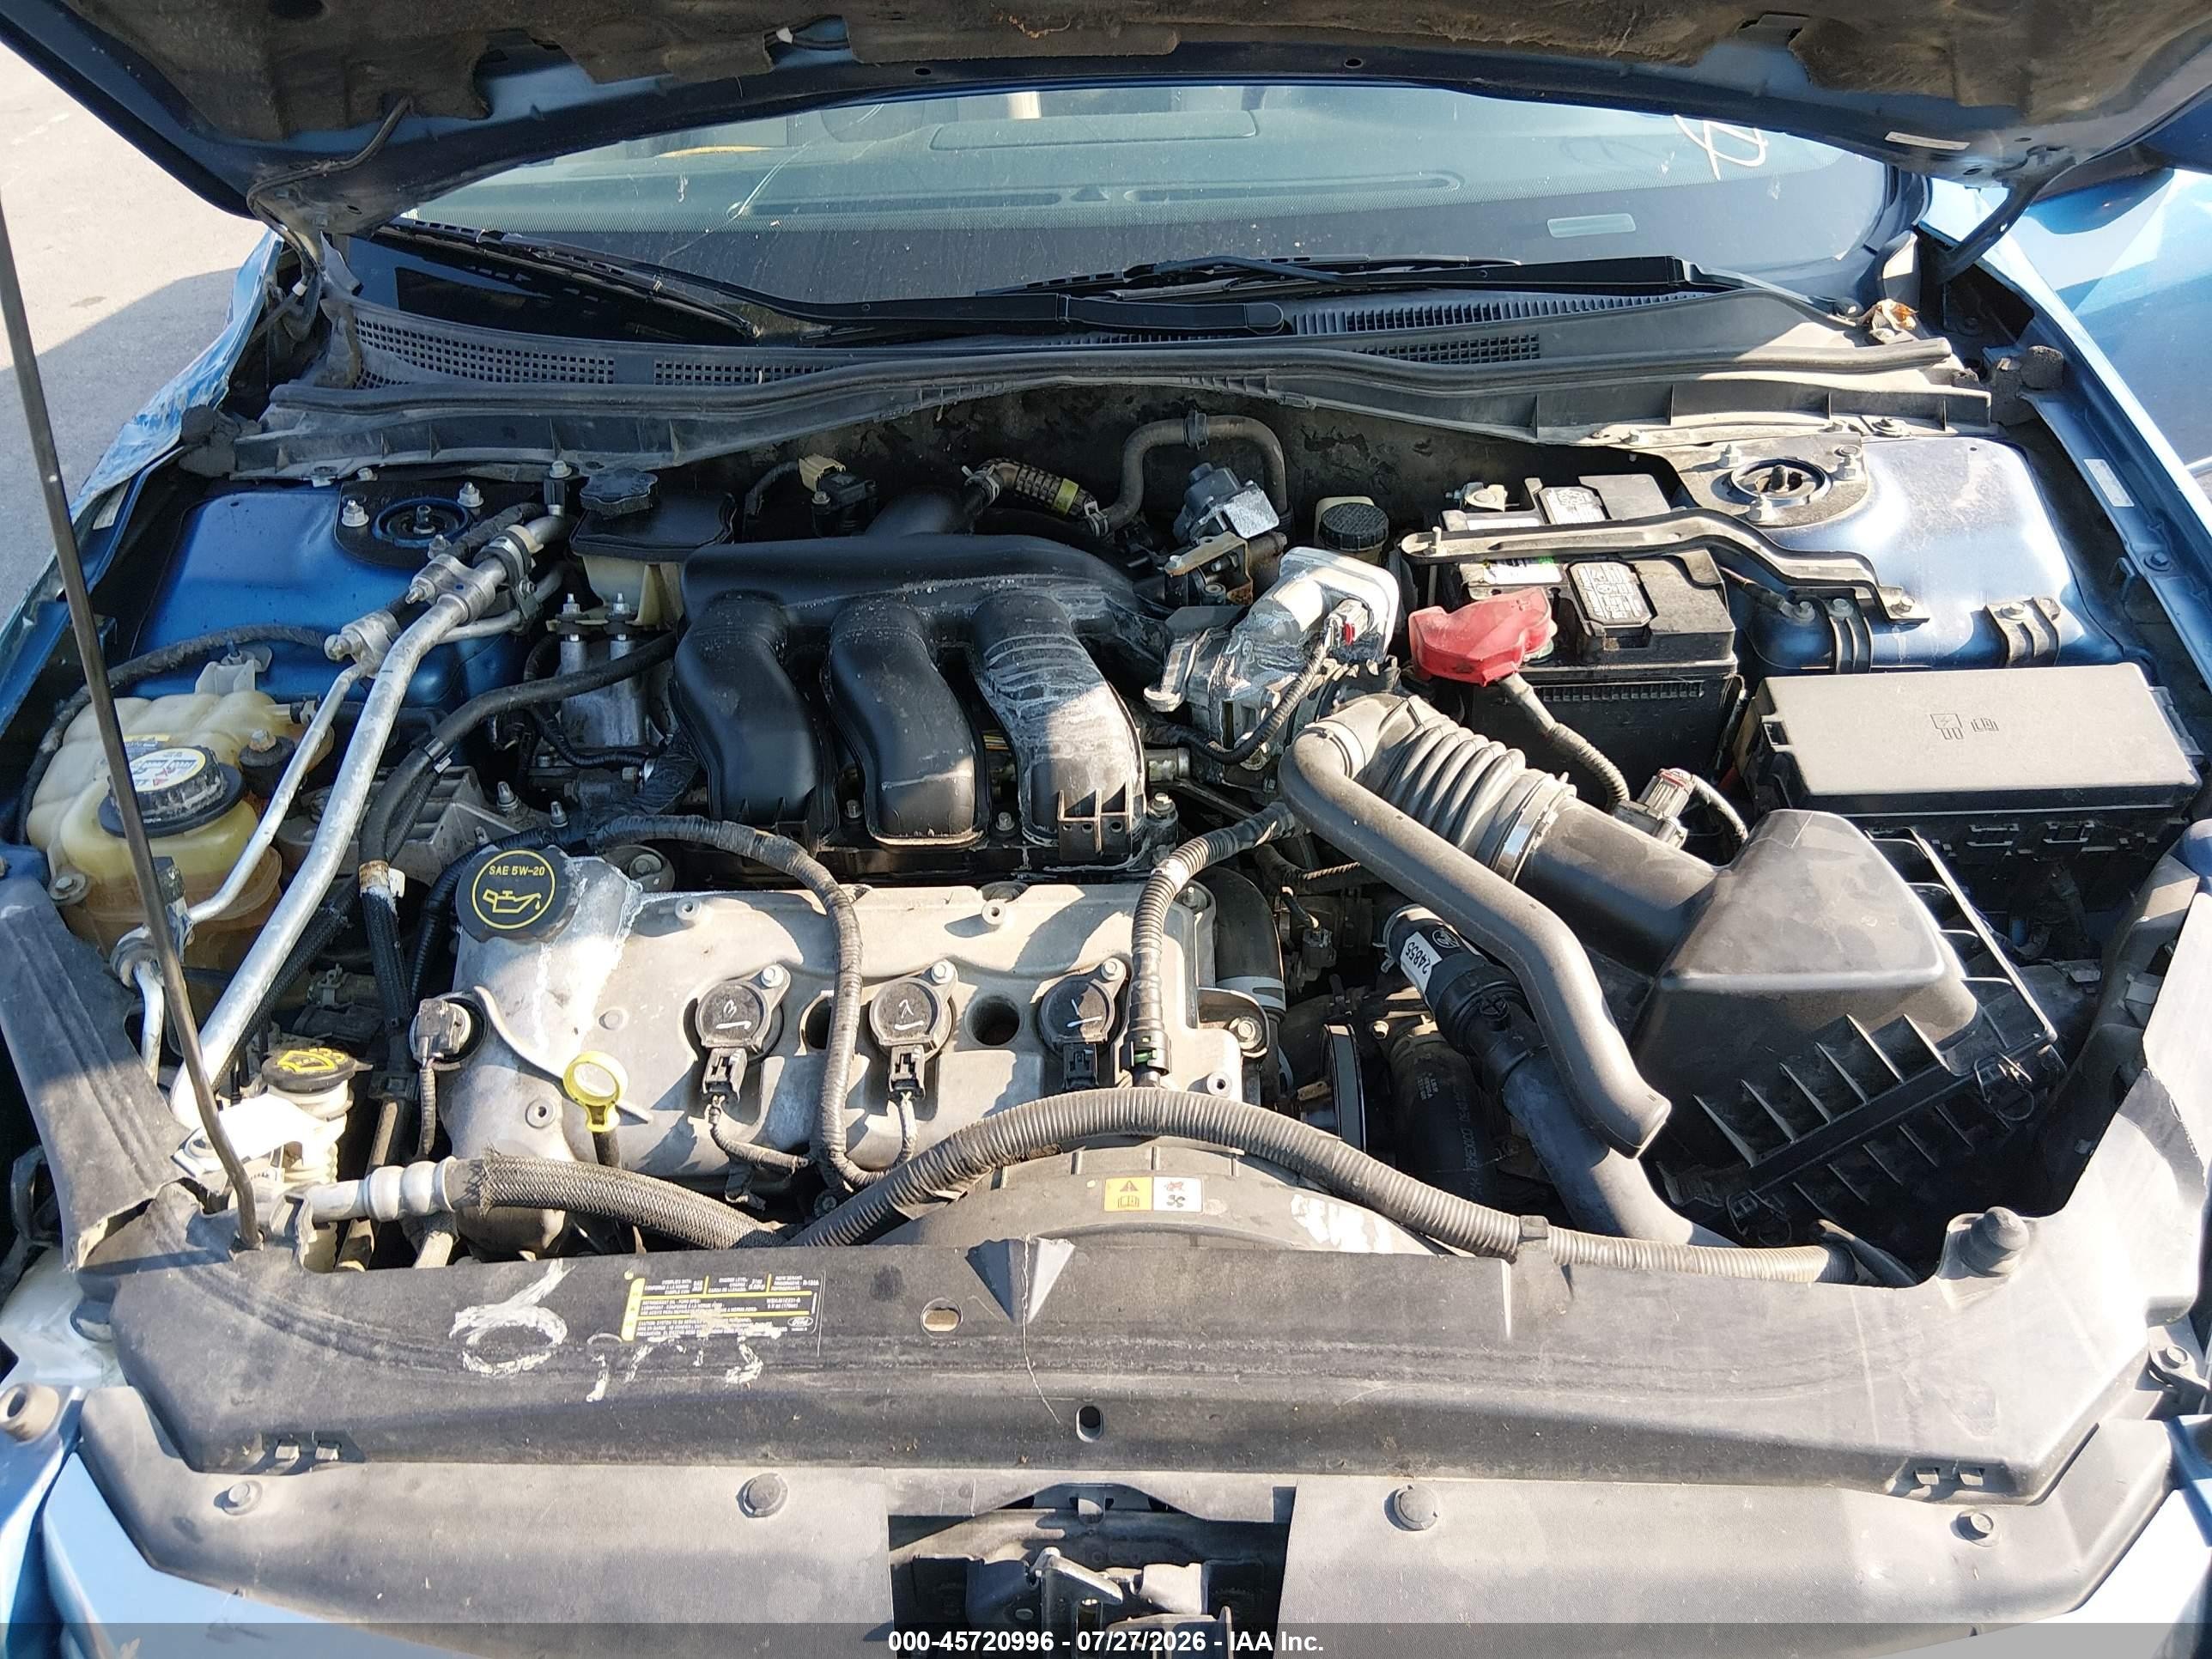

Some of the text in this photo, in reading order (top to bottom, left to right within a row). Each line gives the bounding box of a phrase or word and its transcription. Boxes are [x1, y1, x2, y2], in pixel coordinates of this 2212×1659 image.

[489, 865, 545, 876] SAE 5W-20
[1405, 941, 1431, 975] 24855
